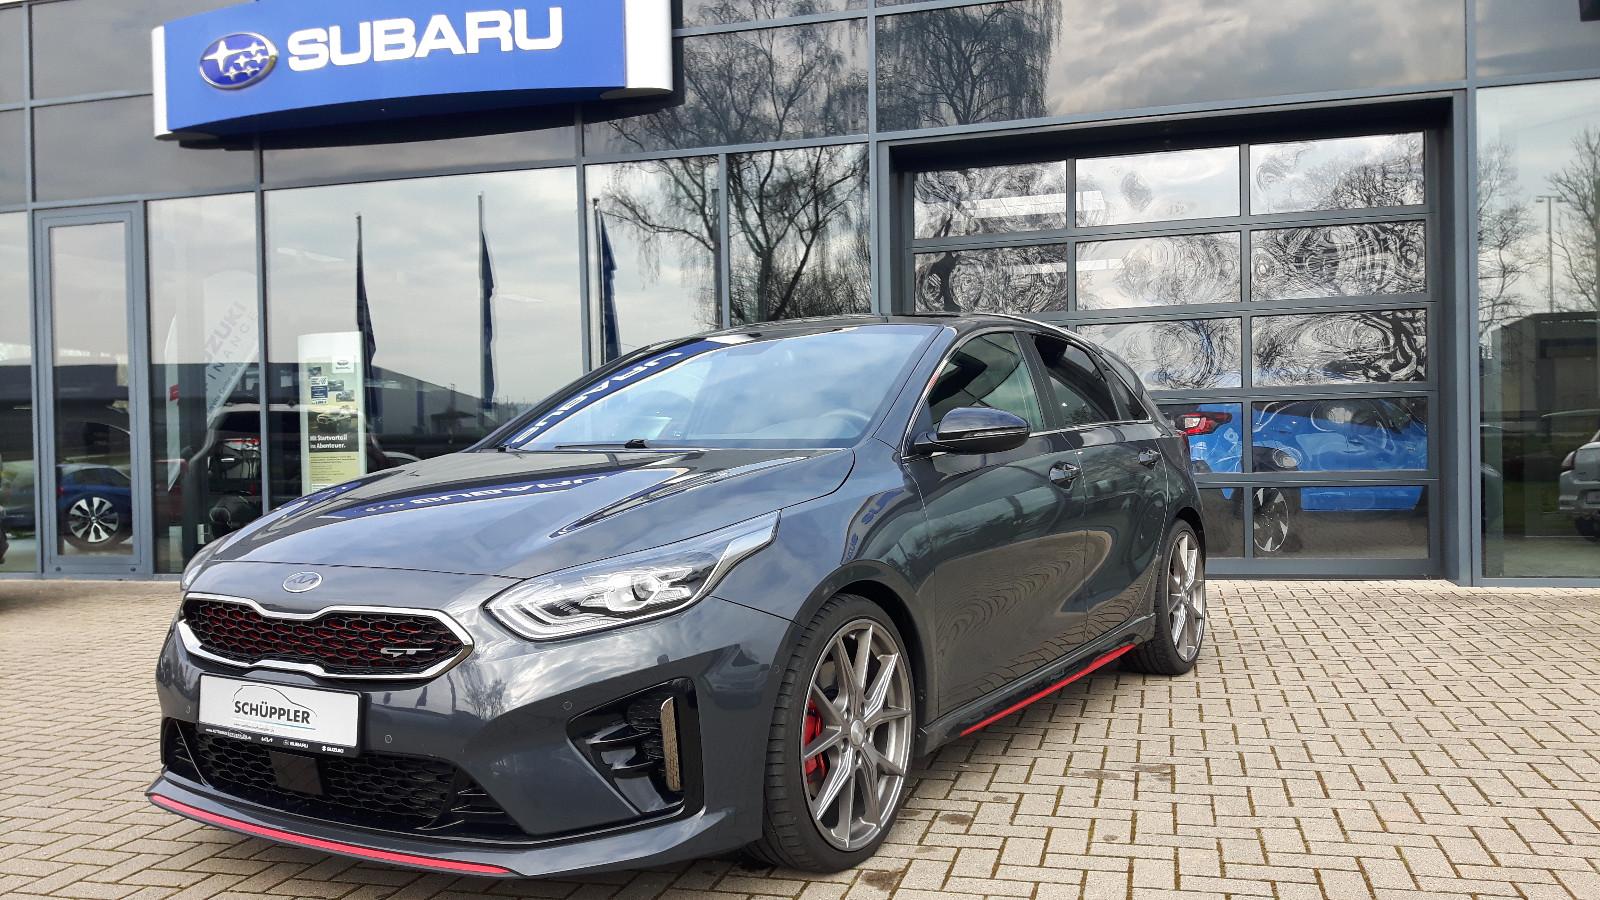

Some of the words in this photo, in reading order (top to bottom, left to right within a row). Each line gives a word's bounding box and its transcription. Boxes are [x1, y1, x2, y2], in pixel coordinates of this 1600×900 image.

[288, 6, 562, 72] SUBARU
[317, 433, 348, 442] Startvorteil
[234, 700, 311, 725] SCHÜPPLER
